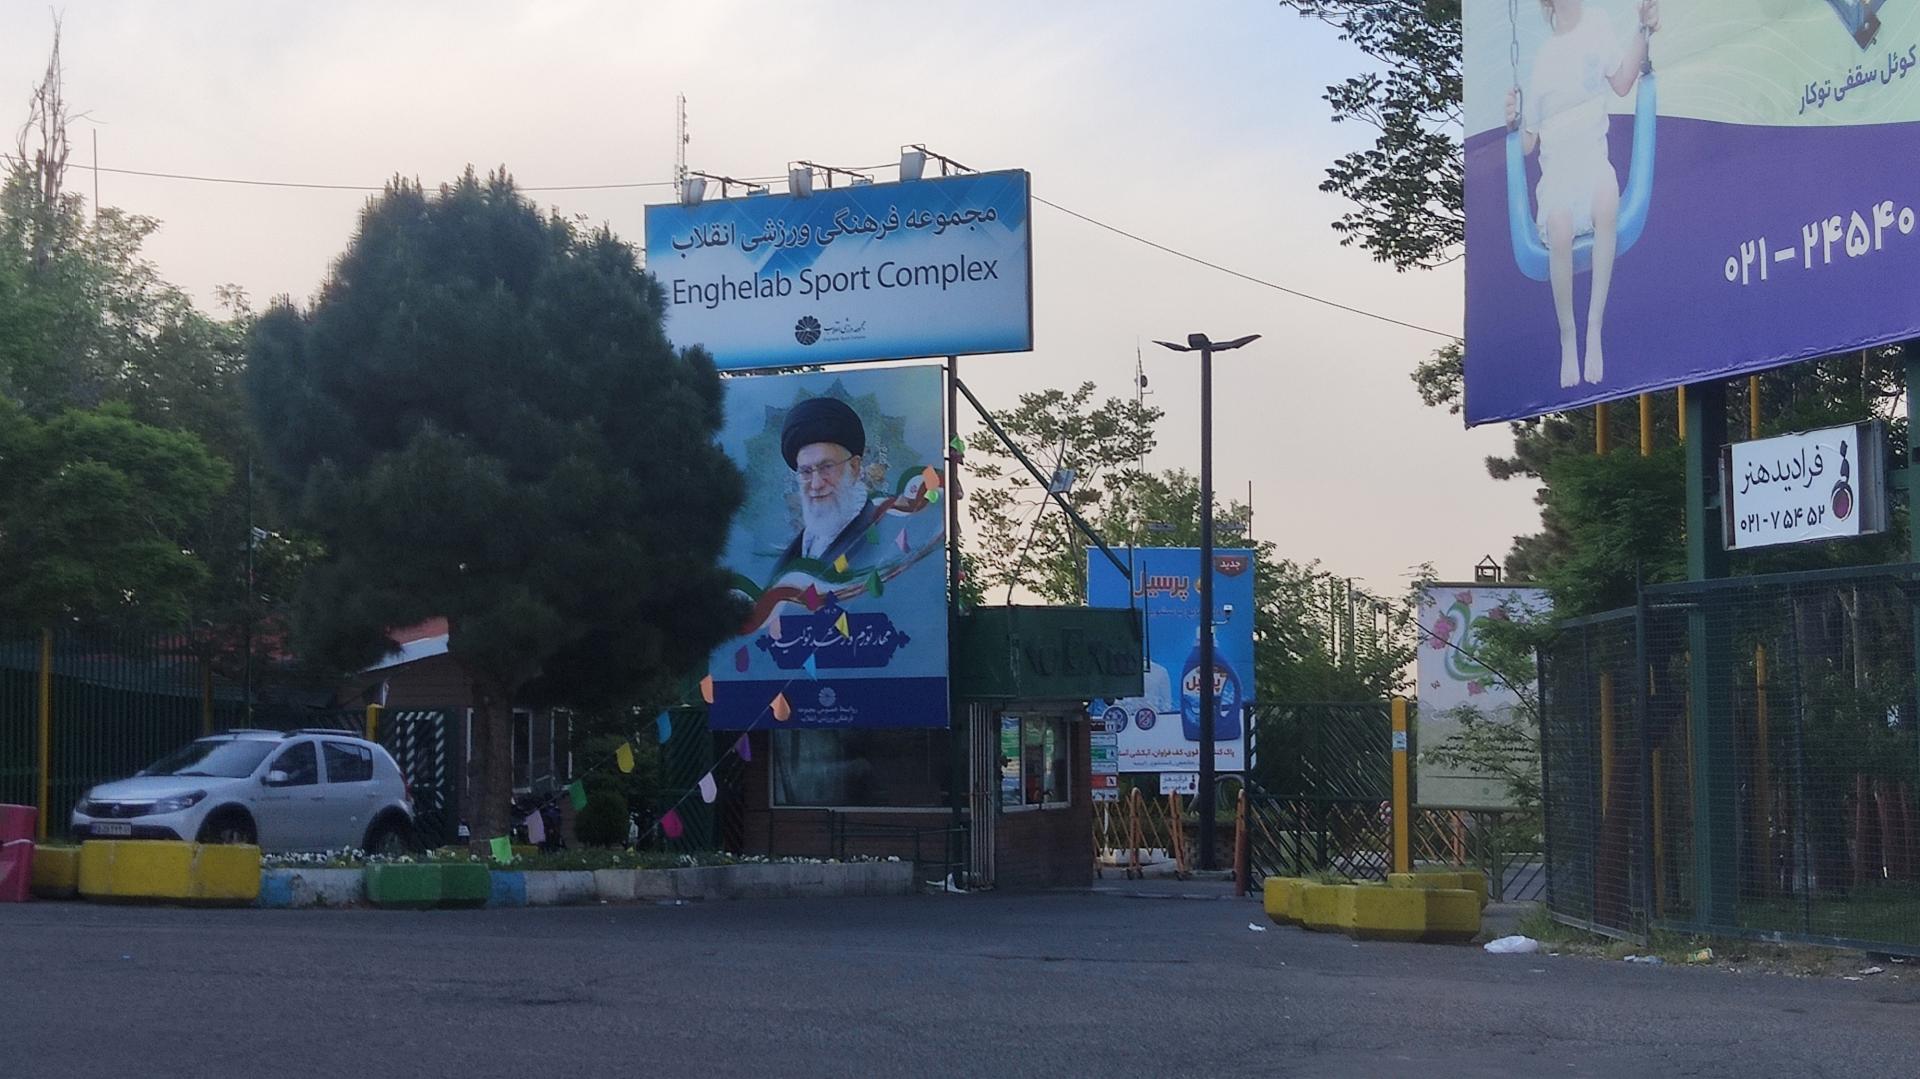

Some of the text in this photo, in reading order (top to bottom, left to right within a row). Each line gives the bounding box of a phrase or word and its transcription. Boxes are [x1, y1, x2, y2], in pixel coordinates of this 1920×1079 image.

[1799, 44, 1917, 115] کوئل سقفی توکار
[672, 206, 998, 260] مجموعه فرهنگی ورزشی انقلاب
[672, 254, 999, 309] Enghelab Sport Complex
[1134, 571, 1189, 601] پرسیل
[1220, 560, 1241, 571] جدید
